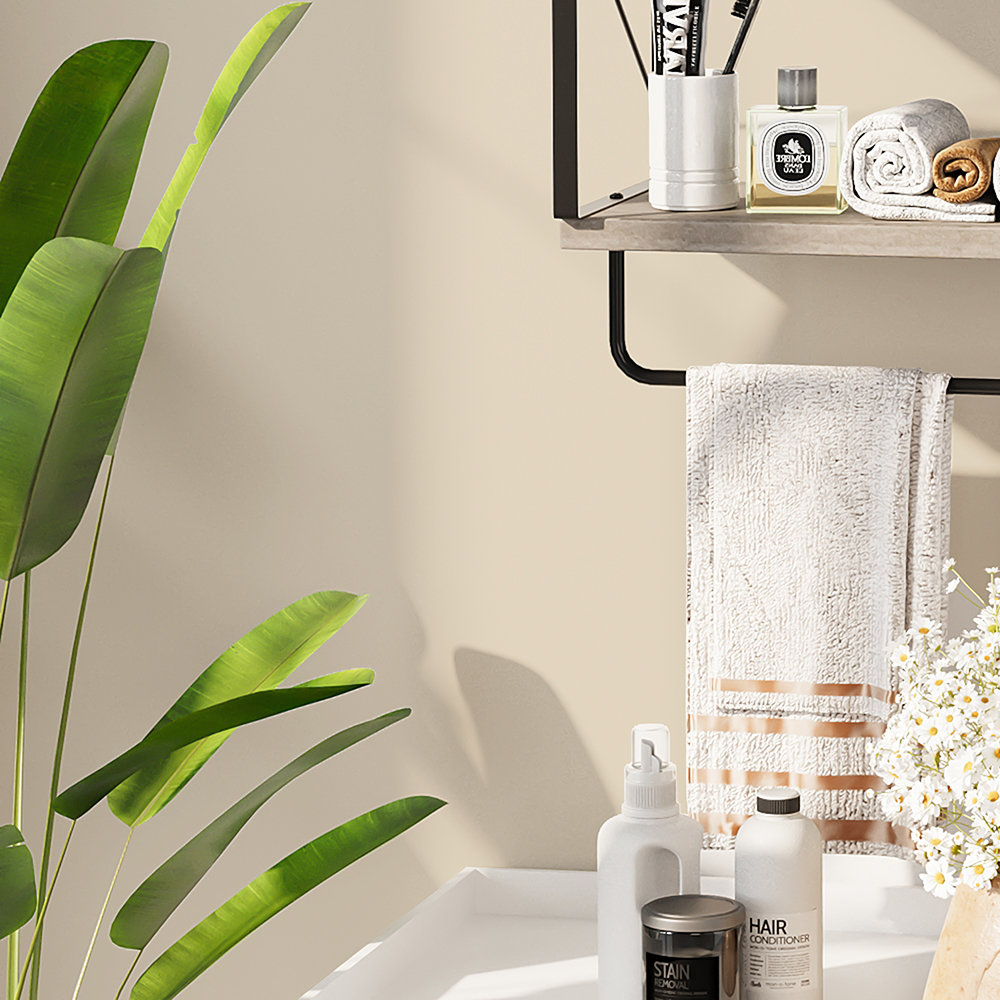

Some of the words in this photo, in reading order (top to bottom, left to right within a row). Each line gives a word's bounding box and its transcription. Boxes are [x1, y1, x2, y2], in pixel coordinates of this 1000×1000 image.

[749, 918, 787, 935] HAIR
[749, 934, 810, 945] CONDITIONER
[653, 961, 690, 980] STAIN
[653, 978, 689, 990] REMOVAL
